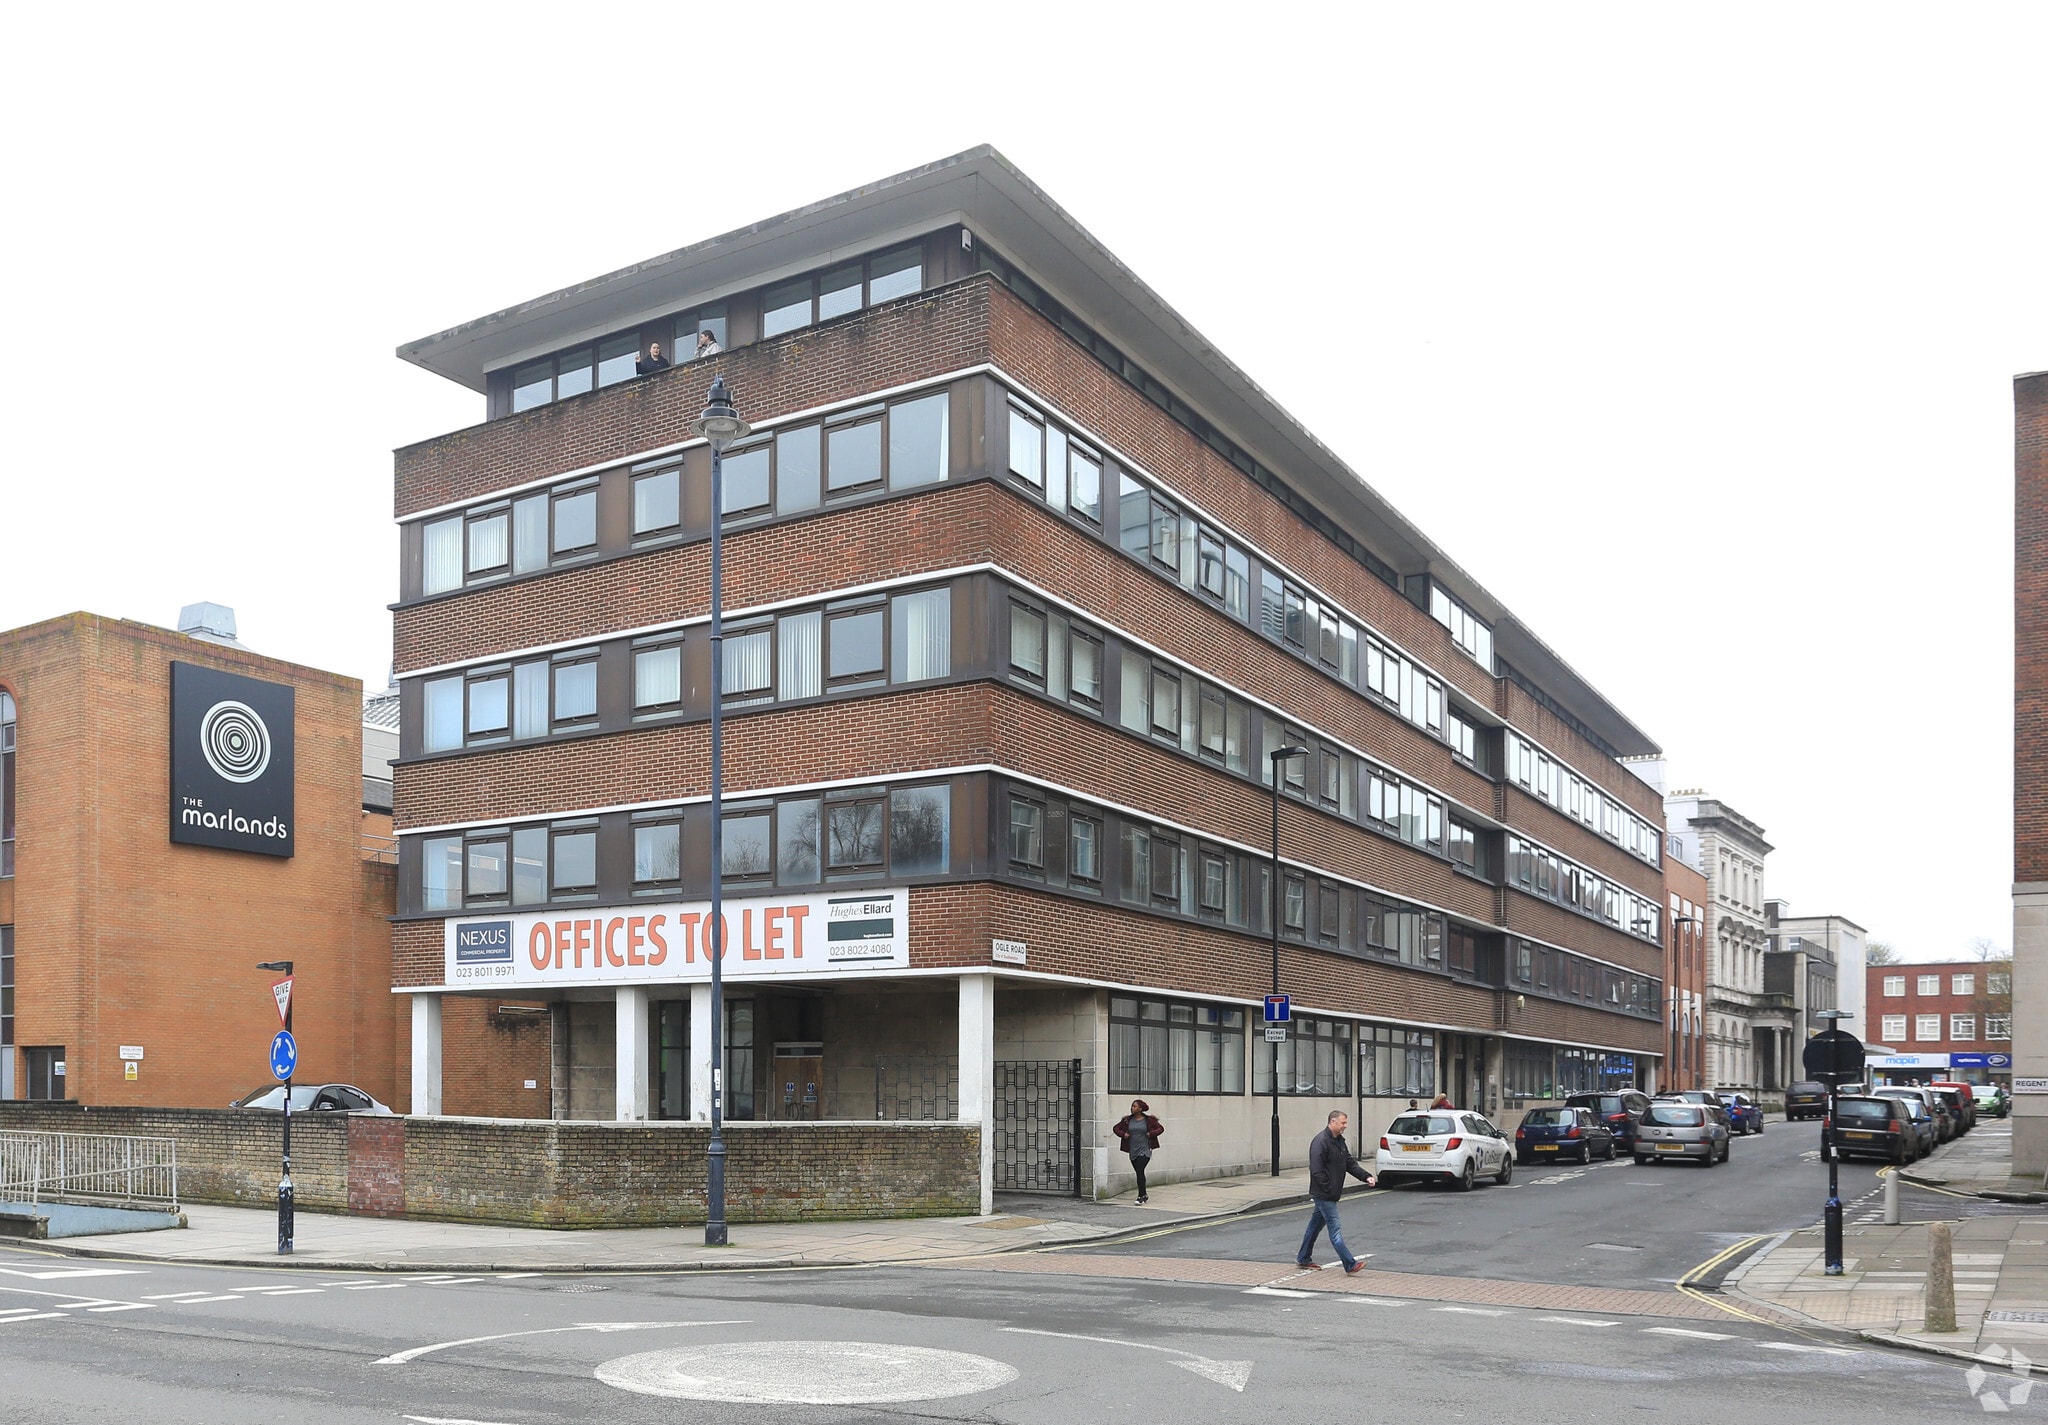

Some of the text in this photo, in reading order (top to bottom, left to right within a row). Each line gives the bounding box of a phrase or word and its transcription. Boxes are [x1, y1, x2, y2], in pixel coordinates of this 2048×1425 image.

[183, 796, 203, 808] THE
[182, 808, 287, 839] marlands
[460, 929, 506, 946] NEXUS
[529, 905, 809, 970] OFFICES TO LET
[829, 944, 892, 956] 023 8022 4080
[995, 942, 1024, 954] OGLE ROAD
[456, 966, 515, 978] 023 8011 9971
[275, 983, 289, 996] GIVE
[1886, 1056, 1920, 1066] maplin
